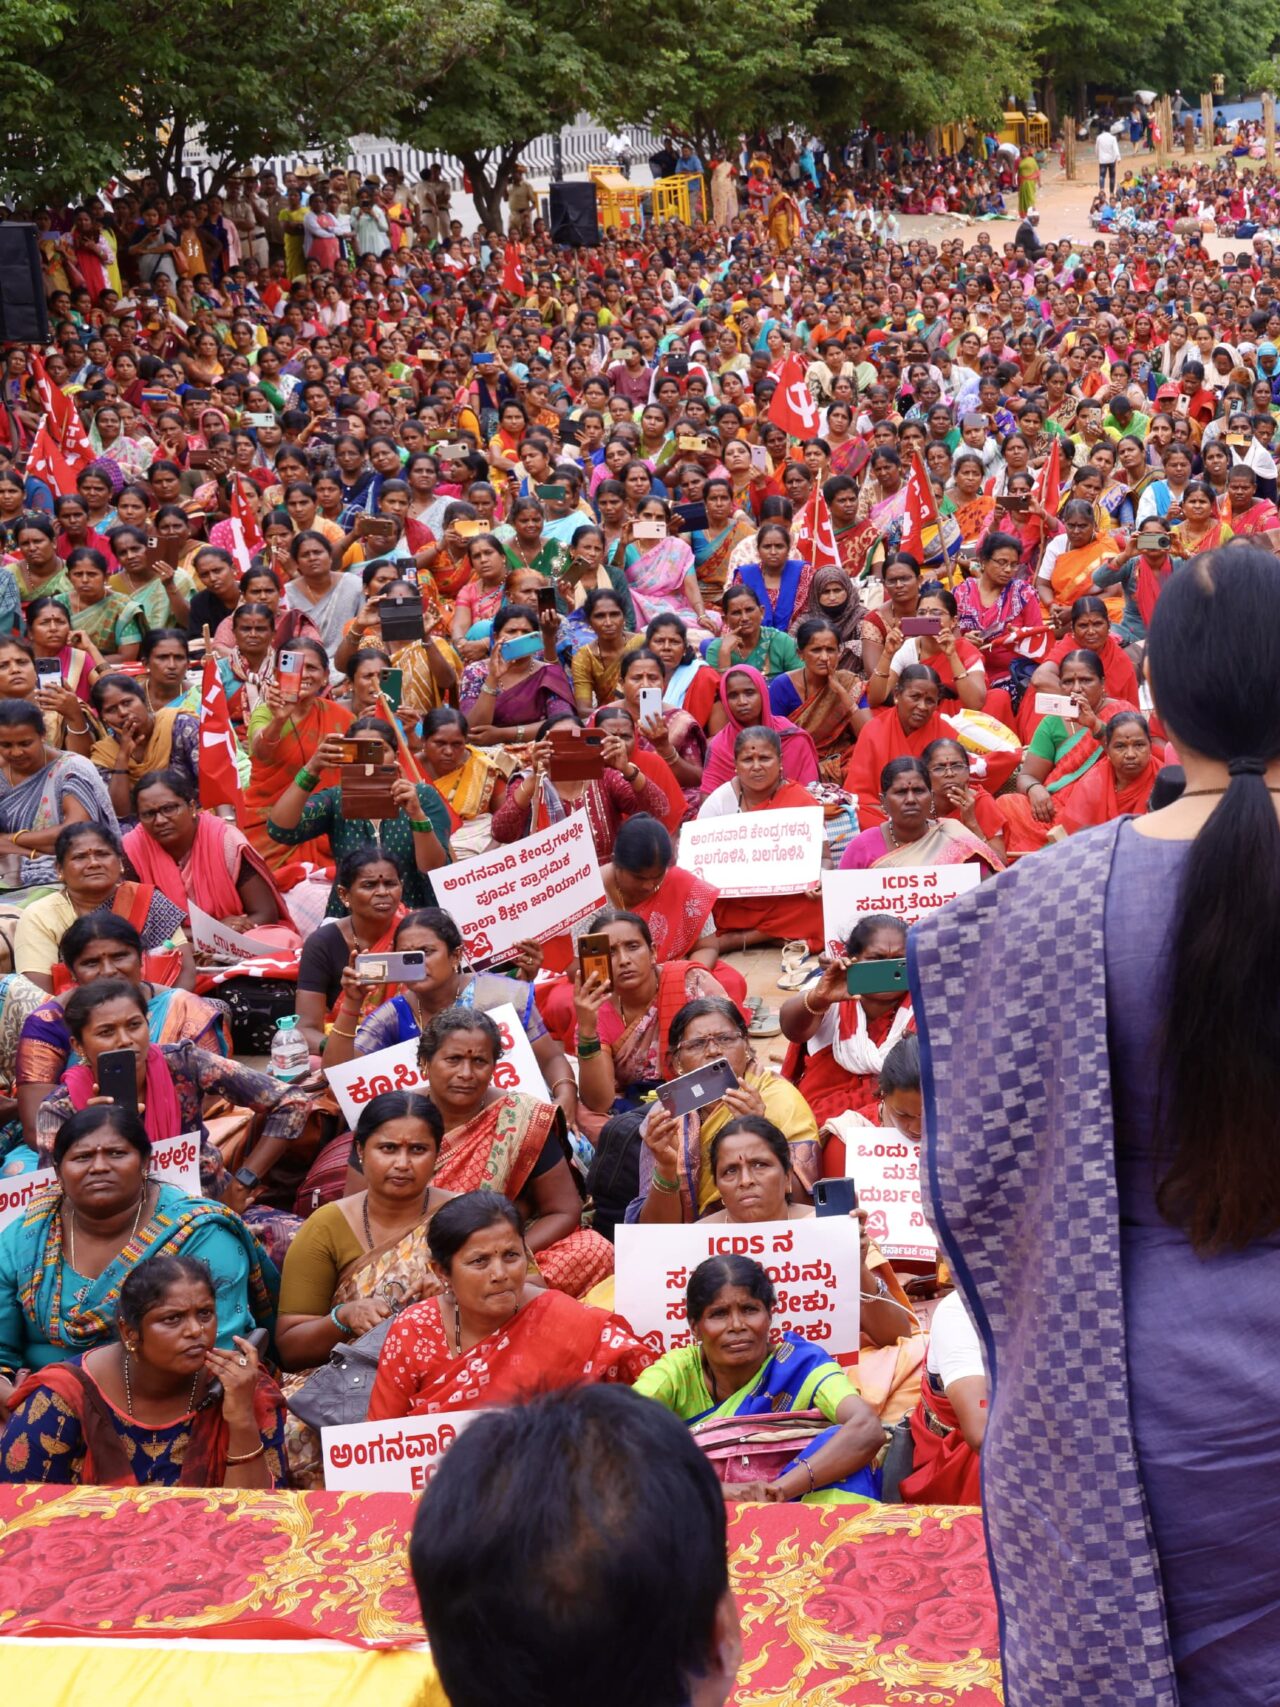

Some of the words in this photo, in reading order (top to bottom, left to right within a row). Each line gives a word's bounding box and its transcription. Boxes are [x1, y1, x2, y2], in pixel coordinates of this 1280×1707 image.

[443, 855, 517, 891] ಅಂಗನವಾಡಿ
[518, 822, 584, 864] ಕೇಂದ್ರಗಳಲ್ಲೇ
[476, 880, 517, 906] ಪೂರ್ವ
[520, 853, 571, 887] ಪ್ರಾಥಮಿಕ
[882, 875, 919, 889] ICDS
[924, 872, 938, 887] ನ
[461, 914, 496, 935] ಶಾಲಾ
[498, 901, 528, 921] ಶಿಕ್ಷಣ
[530, 863, 592, 907] ಜಾರಿಯಾಗಲಿ
[708, 1235, 765, 1256] ICDS
[772, 1230, 793, 1254] ನ
